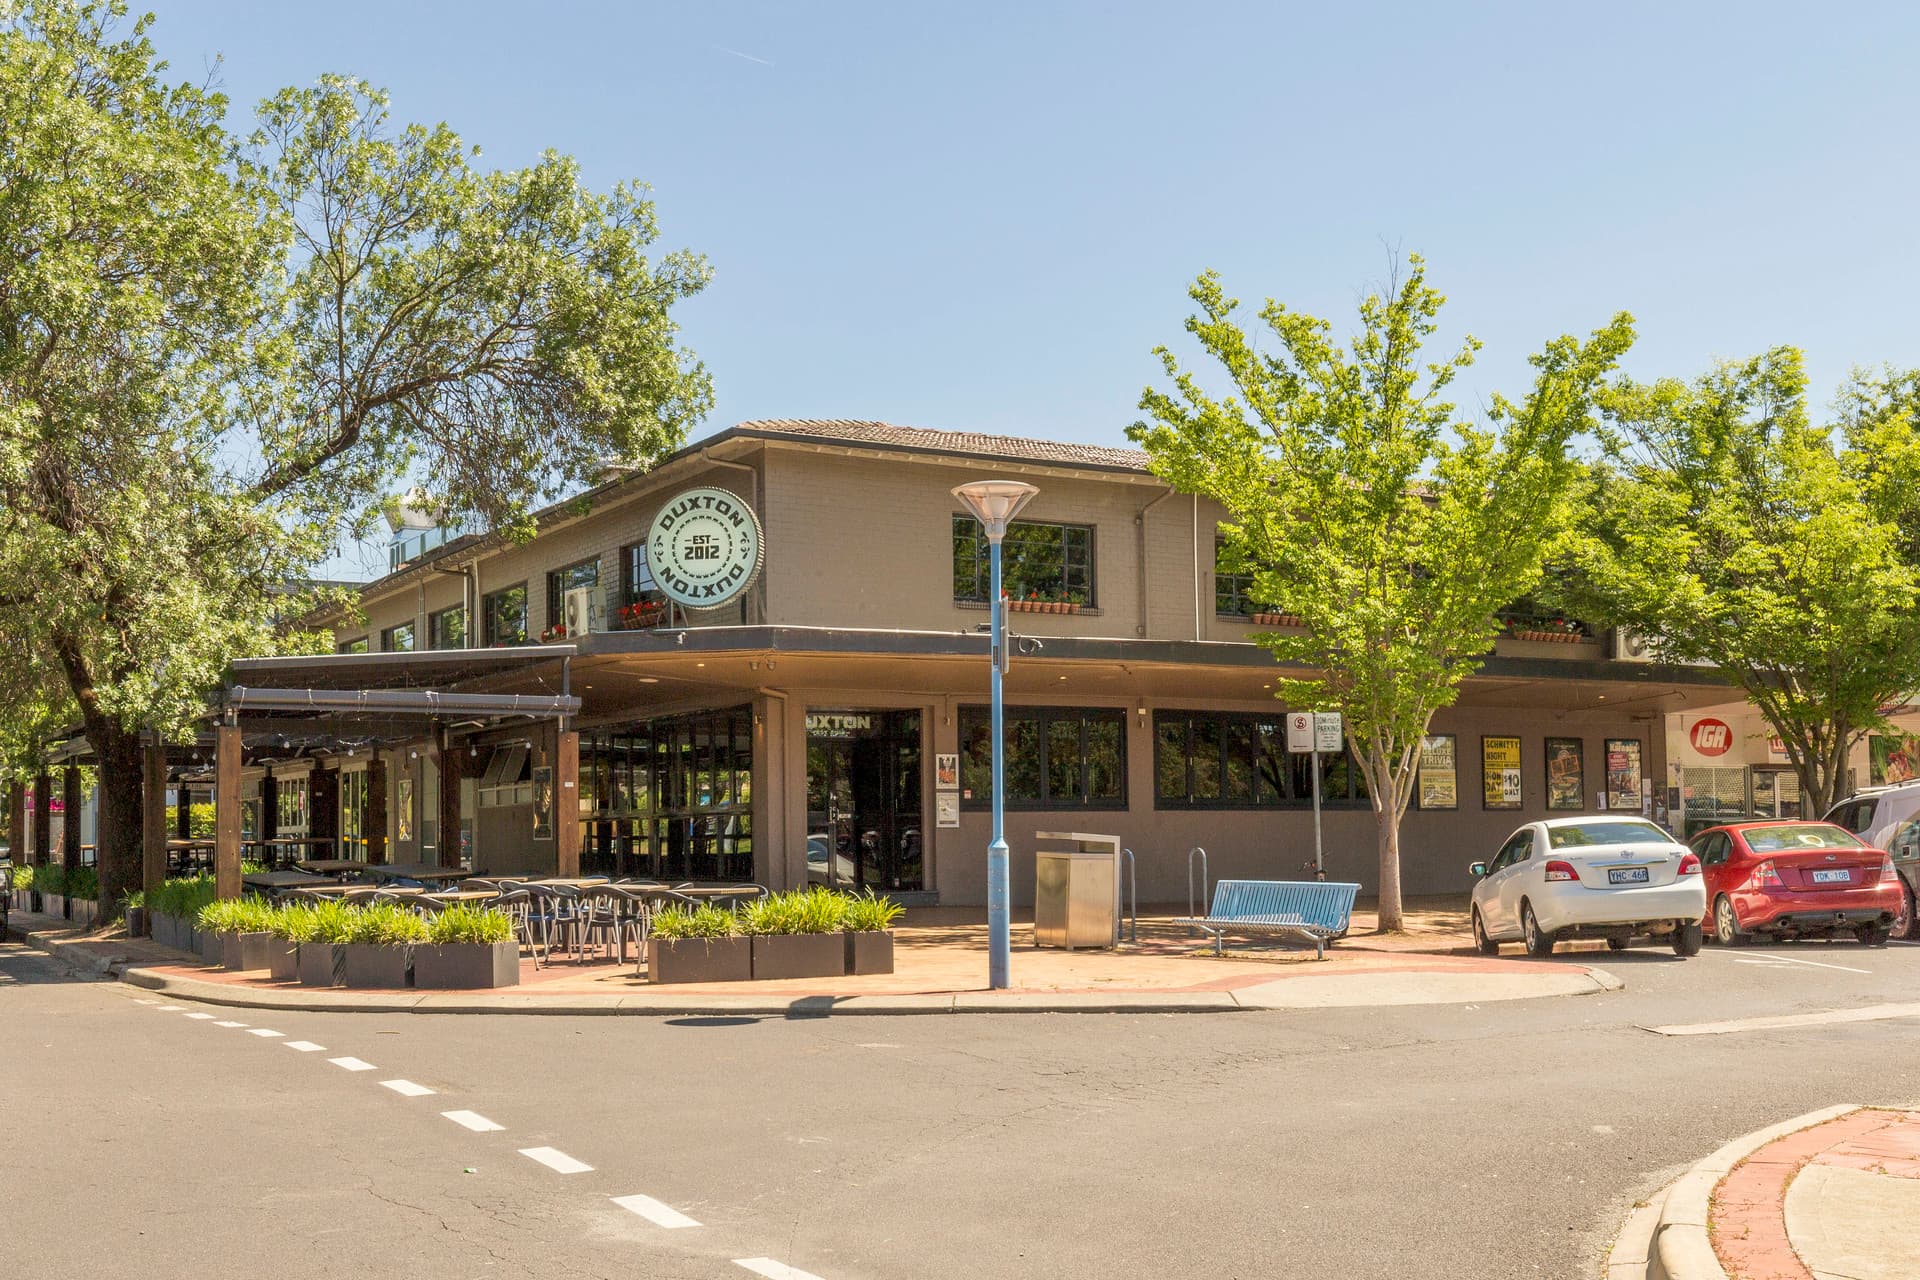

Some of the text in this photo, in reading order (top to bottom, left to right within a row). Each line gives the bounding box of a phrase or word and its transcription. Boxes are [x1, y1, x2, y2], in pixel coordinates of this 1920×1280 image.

[659, 496, 744, 531] DUXTON
[692, 535, 711, 545] EST
[684, 545, 720, 560] 2012
[659, 563, 745, 598] DUXTON
[806, 715, 870, 729] UXTON
[1317, 725, 1340, 733] PARKING
[1696, 725, 1727, 748] IGA
[1423, 748, 1452, 756] DELUXE
[1486, 751, 1507, 761] NIGHT
[1423, 756, 1453, 765] TRIVIA
[1503, 774, 1520, 788] $10
[1486, 782, 1502, 793] DAY
